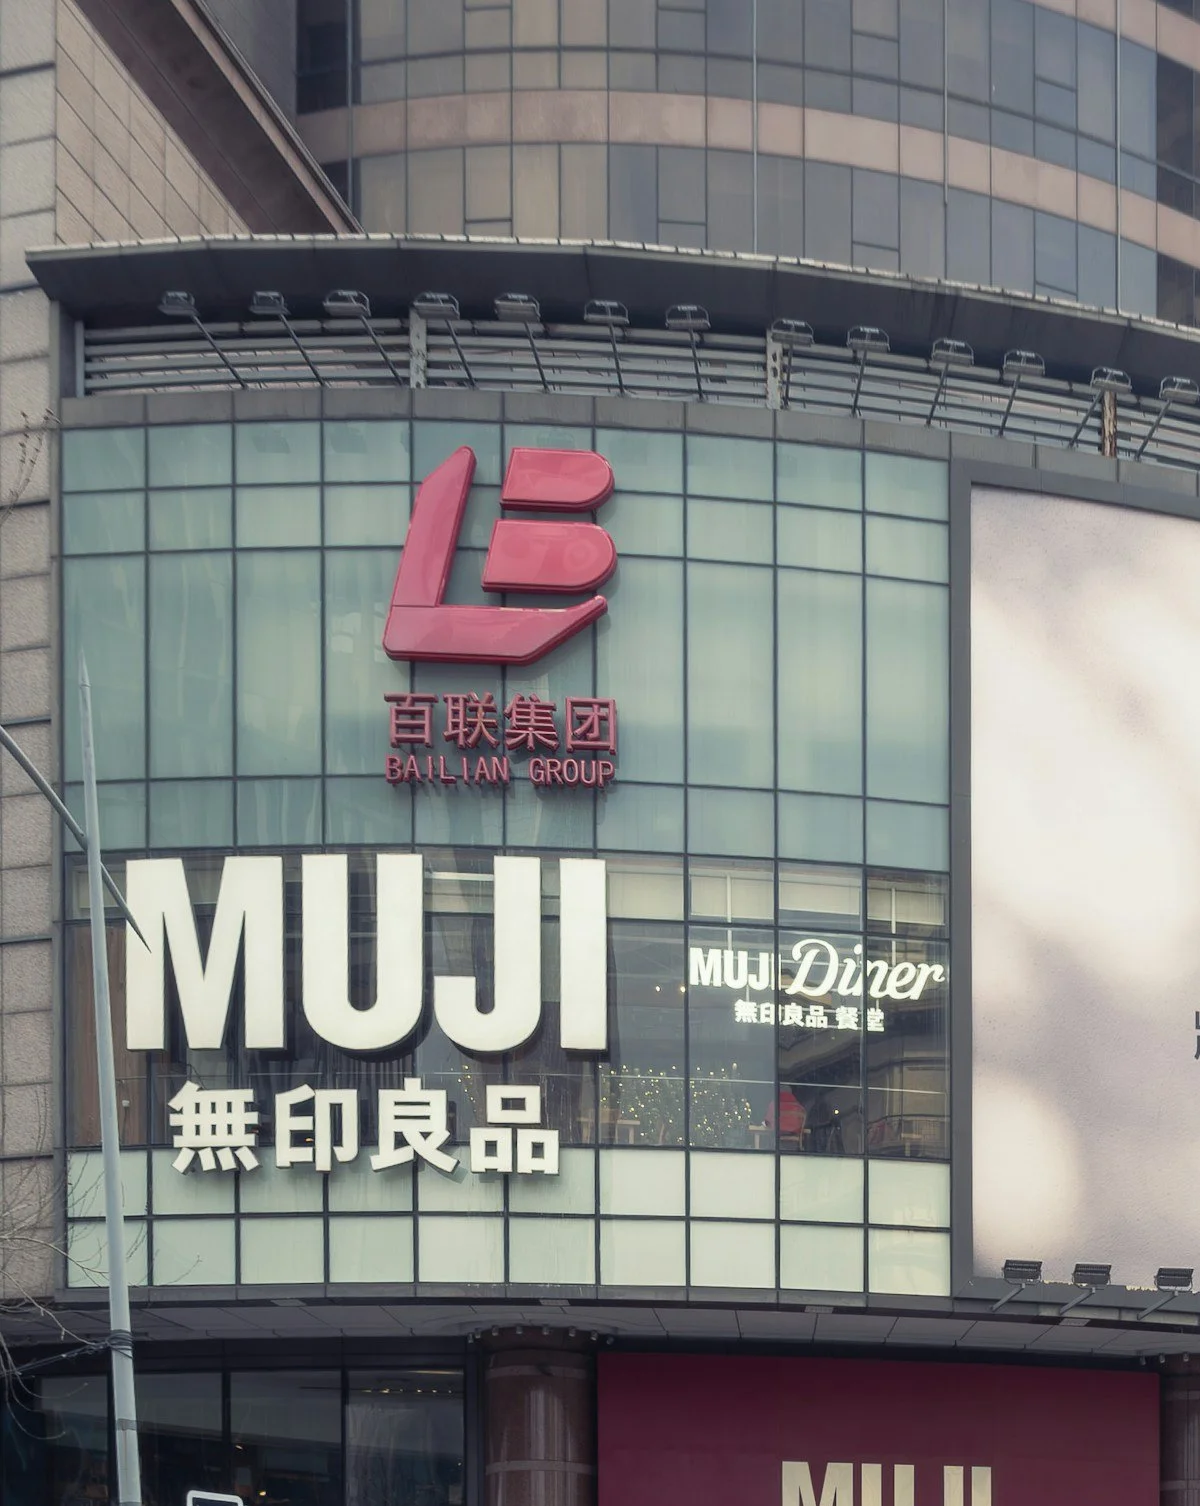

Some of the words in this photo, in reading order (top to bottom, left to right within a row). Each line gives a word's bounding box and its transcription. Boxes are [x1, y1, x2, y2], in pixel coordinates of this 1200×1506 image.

[385, 691, 617, 755] 百联集团
[385, 754, 510, 785] BAILIAN
[529, 757, 616, 788] GROUP
[126, 853, 607, 1052] MUJI
[689, 947, 782, 991] MUJI
[785, 938, 946, 1001] Diner
[734, 998, 828, 1029] 無印良品
[168, 1077, 560, 1176] 無印良品
